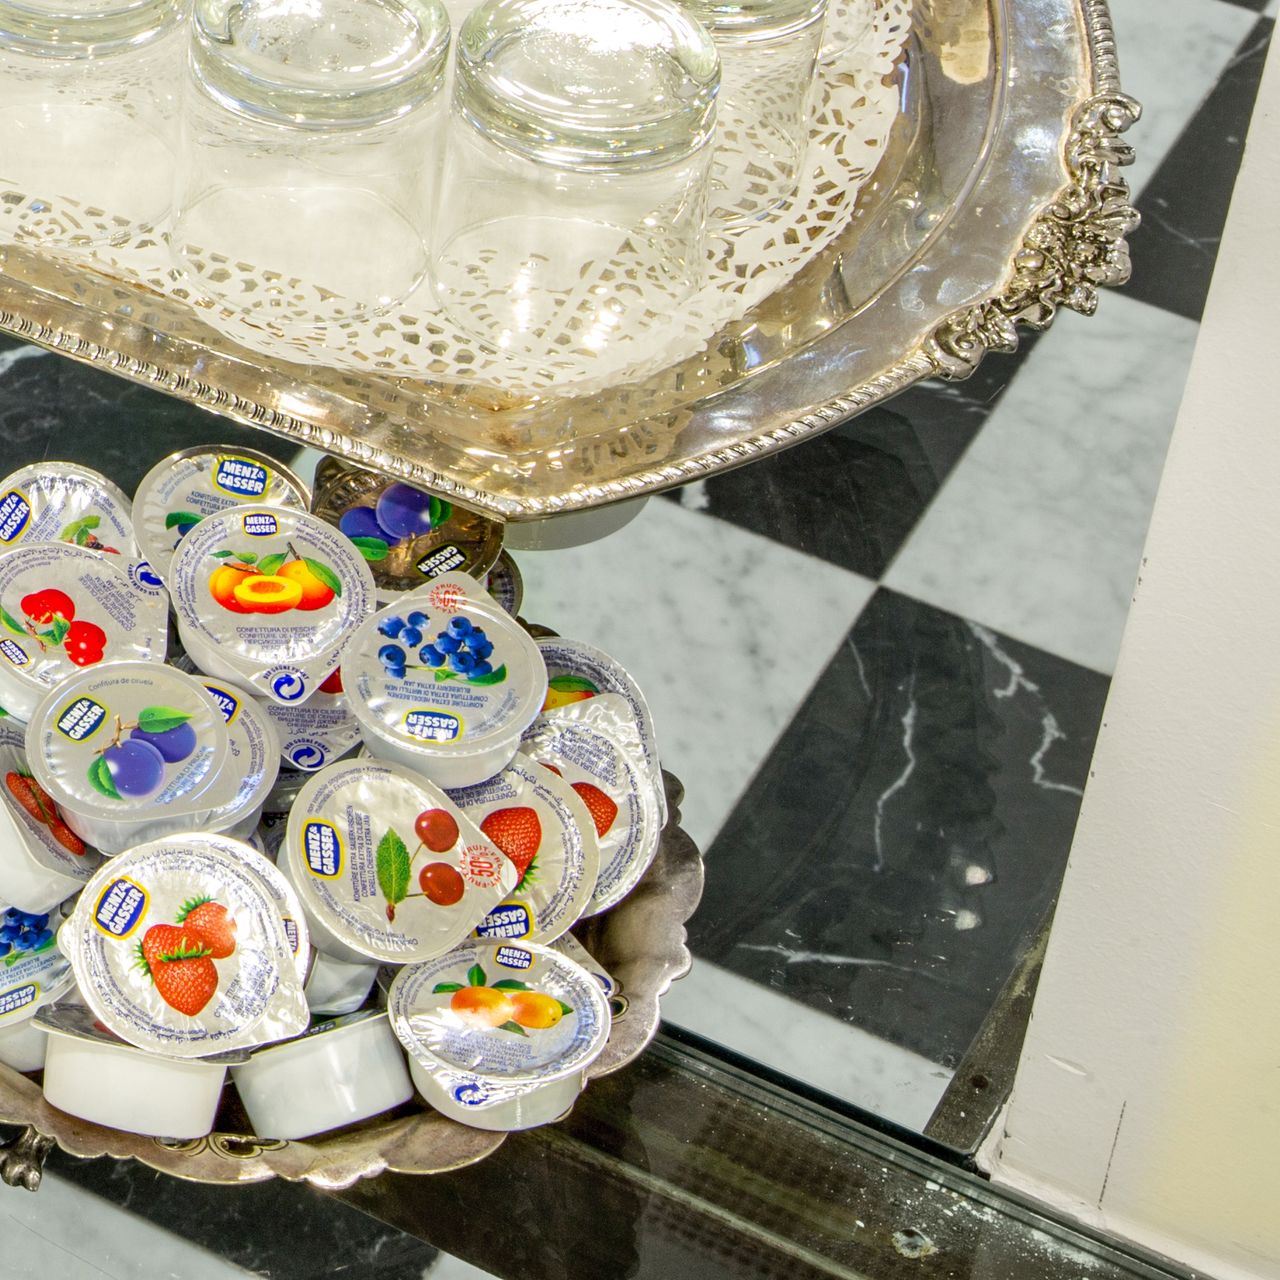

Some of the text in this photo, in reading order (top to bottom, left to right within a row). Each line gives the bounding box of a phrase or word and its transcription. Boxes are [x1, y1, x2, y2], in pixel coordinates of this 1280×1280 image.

[222, 461, 264, 480] MENZ&
[217, 473, 264, 494] GASSER
[245, 524, 276, 534] GASSER
[246, 516, 275, 525] MENZ&
[58, 700, 90, 732] MENZ&
[69, 706, 105, 739] GASSER
[408, 714, 458, 729] GASSER
[308, 825, 320, 870] MENZ&
[320, 825, 334, 875] GASSER
[97, 879, 130, 925] MENZ&
[109, 890, 142, 936] GASSER
[496, 955, 530, 969] GASSER
[499, 948, 530, 960] MENZ&
